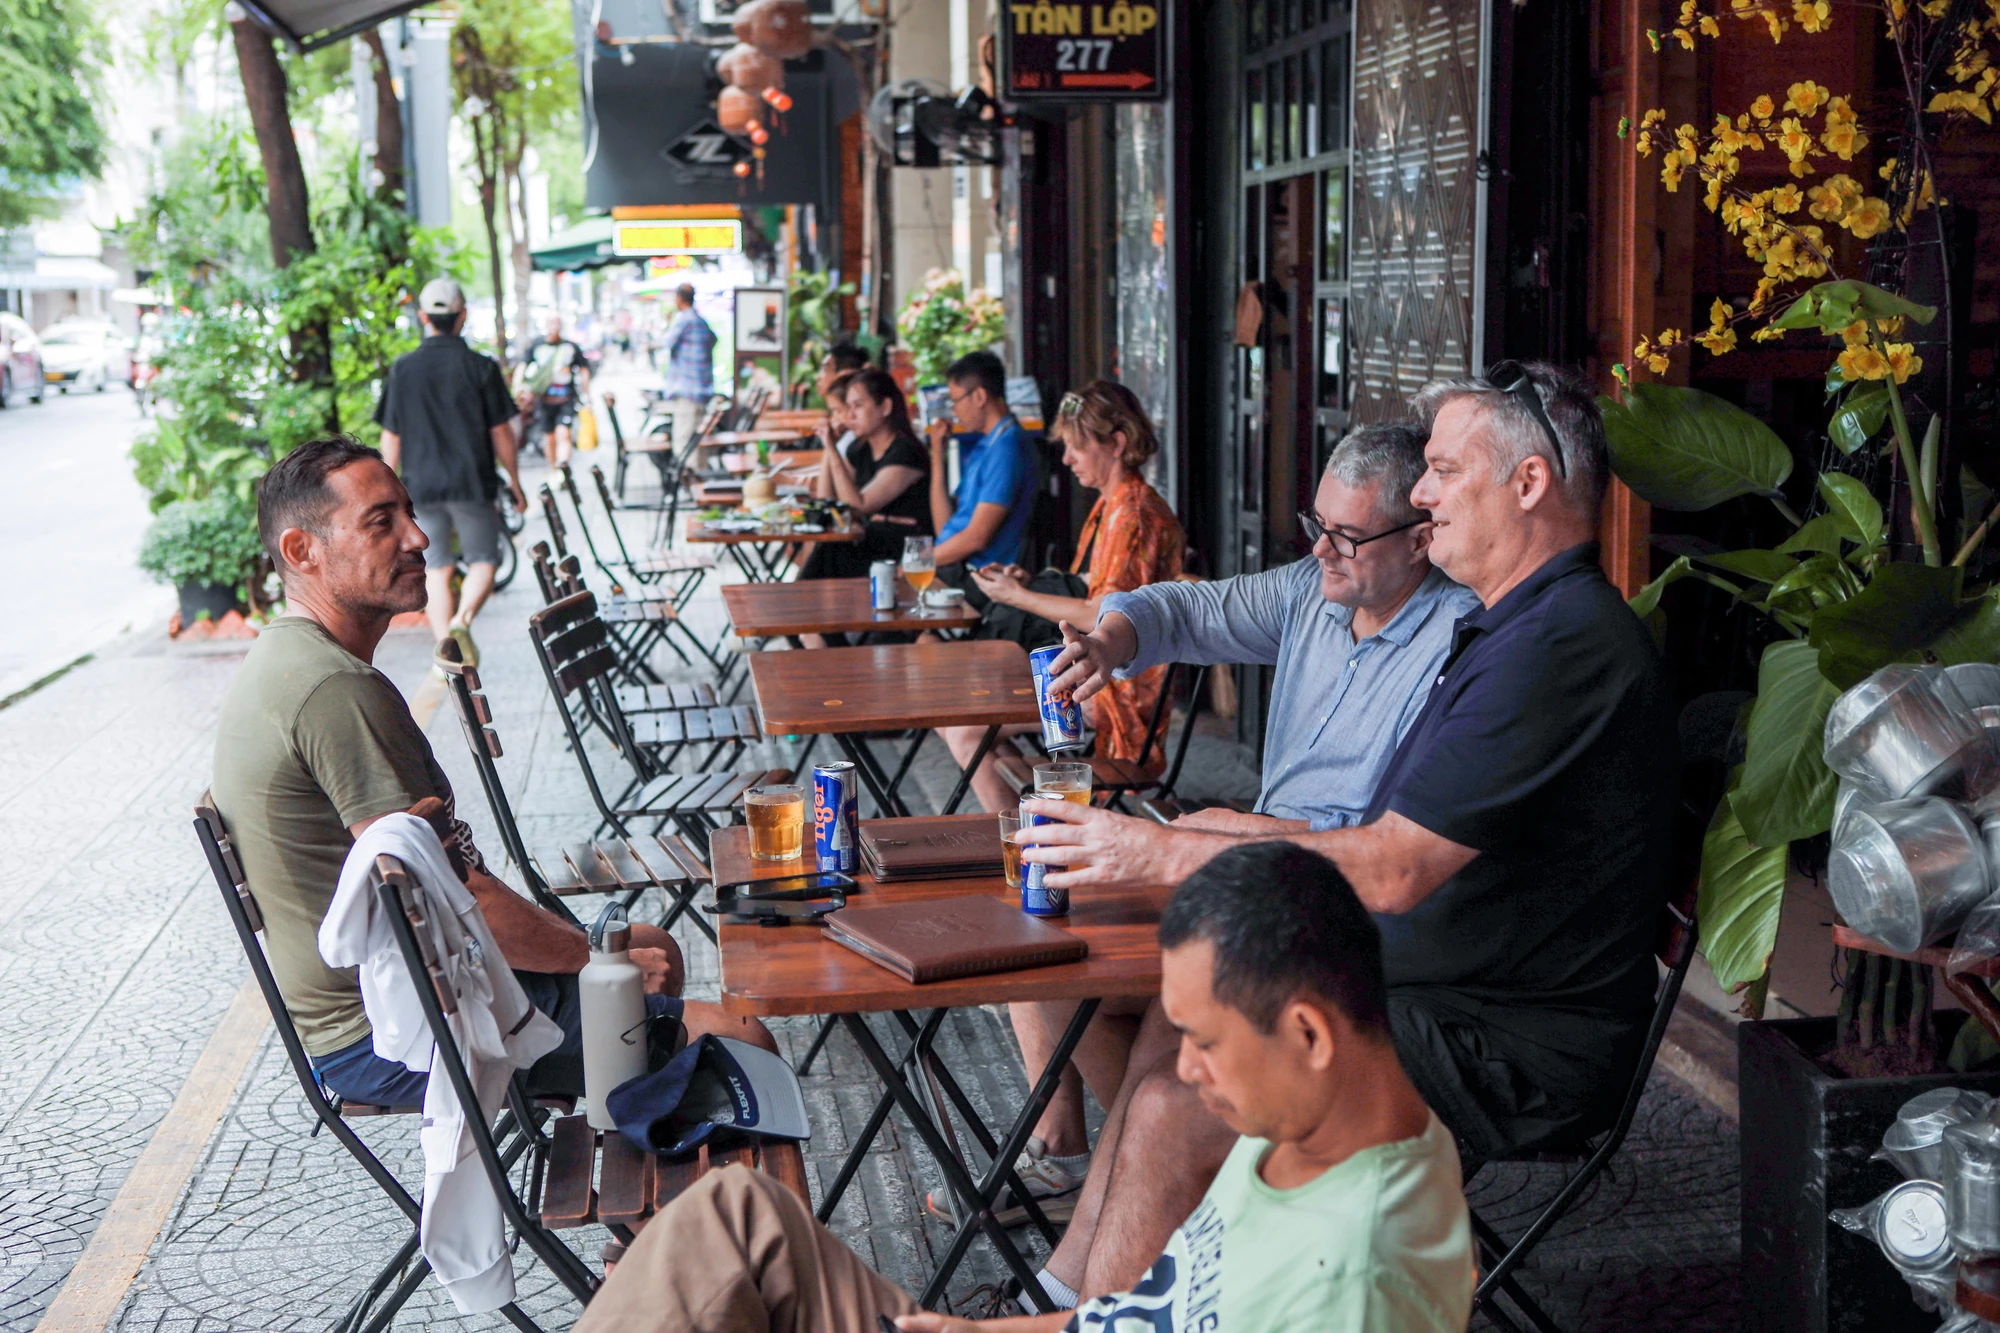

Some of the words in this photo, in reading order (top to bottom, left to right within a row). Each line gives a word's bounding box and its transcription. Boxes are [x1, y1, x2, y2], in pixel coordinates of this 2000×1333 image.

[1011, 0, 1081, 34] TÂN
[1091, 0, 1158, 42] LẬP
[1057, 40, 1112, 70] 277
[729, 1076, 751, 1119] FLEXFIT
